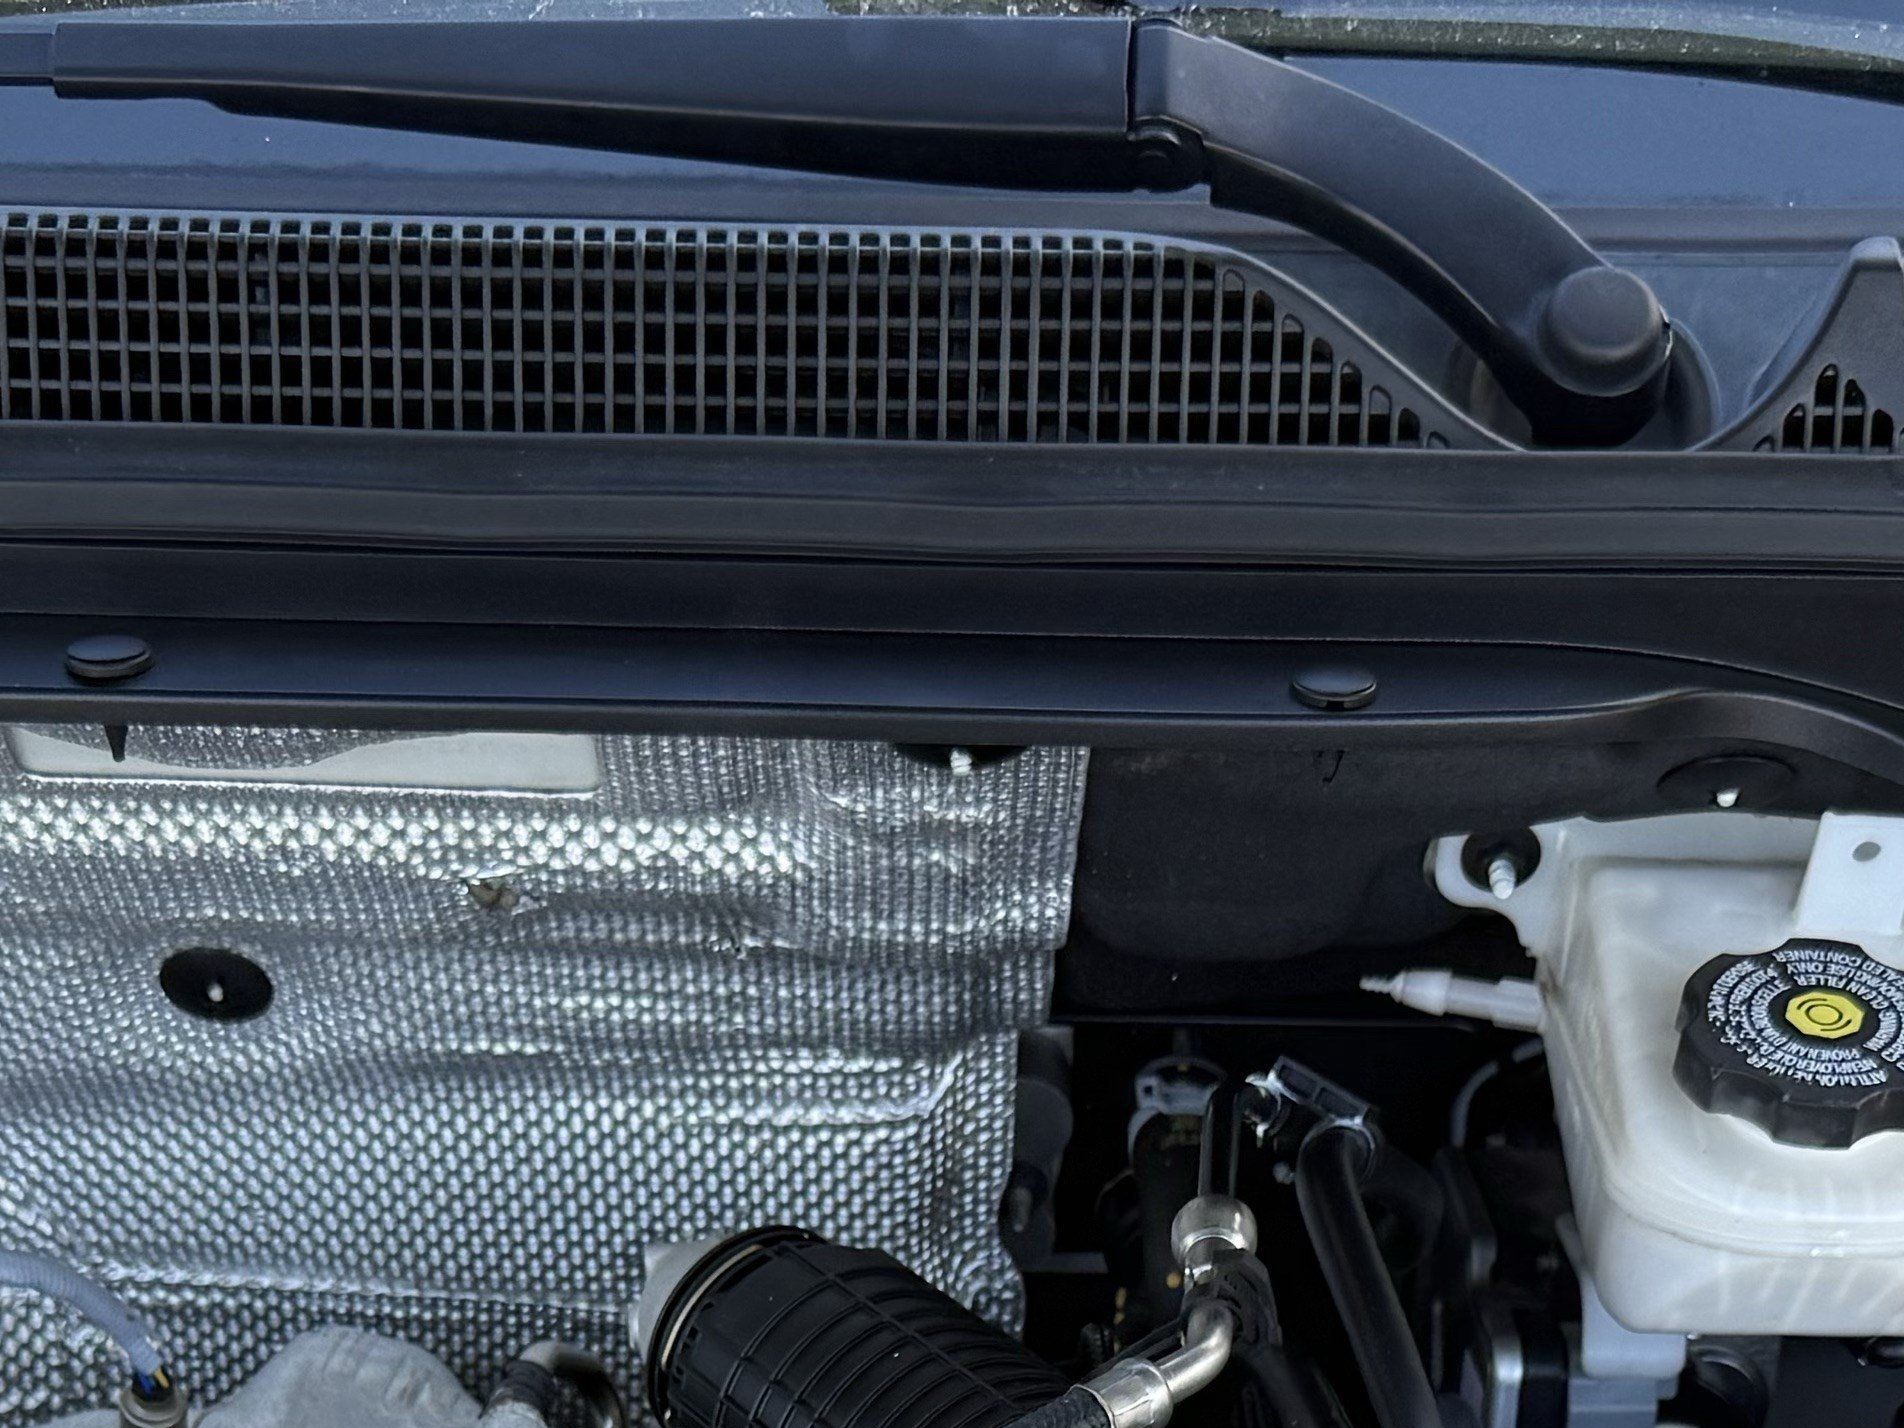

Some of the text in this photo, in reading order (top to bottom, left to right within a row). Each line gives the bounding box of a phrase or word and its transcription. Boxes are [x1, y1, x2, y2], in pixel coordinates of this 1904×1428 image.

[1771, 949, 1863, 968] CONTAINER
[1783, 960, 1823, 975] ONLY
[1825, 961, 1855, 978] USE
[1792, 973, 1848, 989] FILLER
